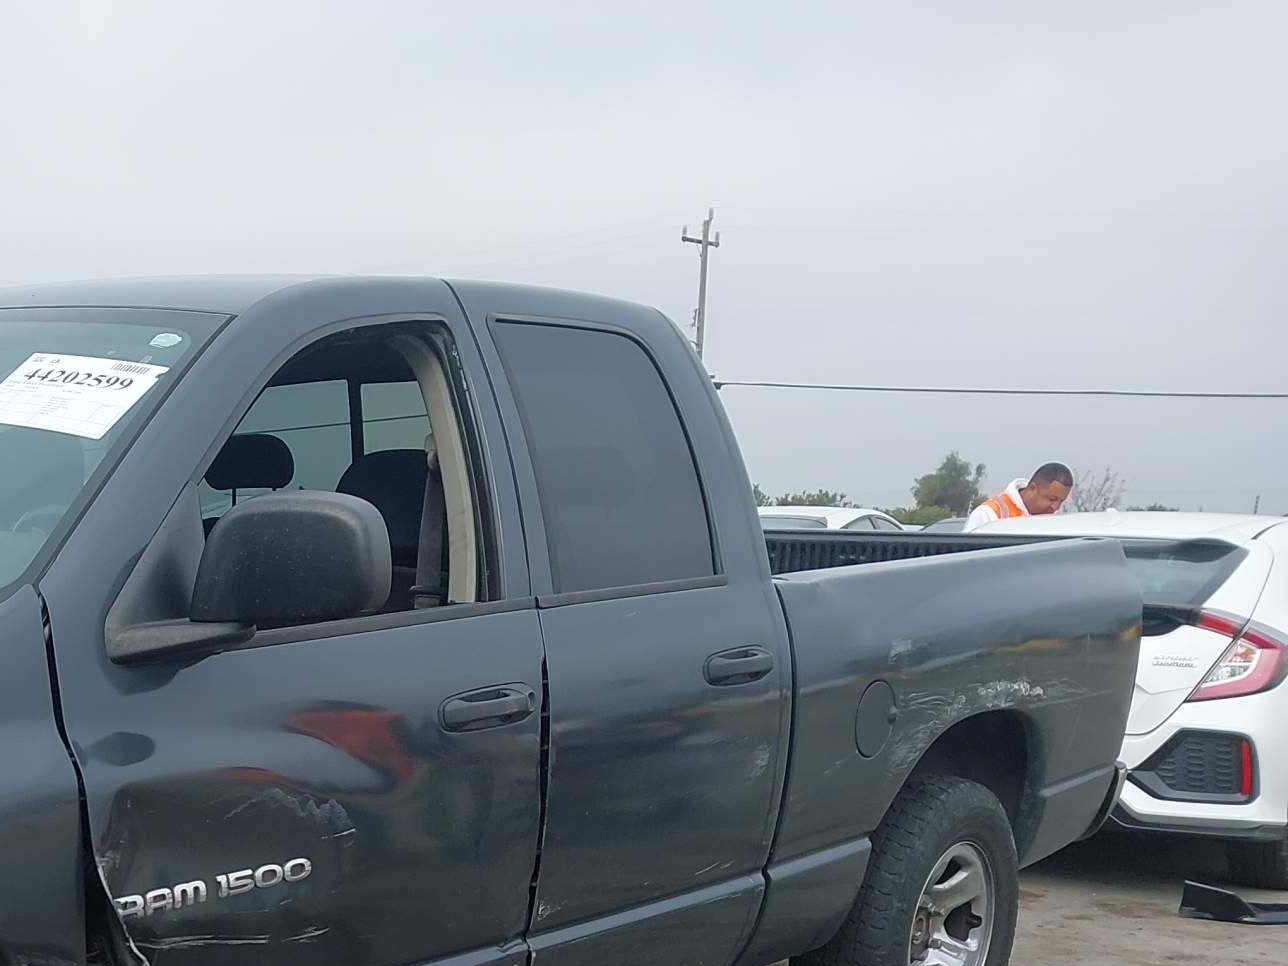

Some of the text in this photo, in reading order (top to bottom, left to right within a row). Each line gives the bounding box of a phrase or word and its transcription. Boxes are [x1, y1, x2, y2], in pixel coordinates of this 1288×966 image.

[23, 367, 134, 391] 44202599
[113, 857, 312, 919] RAM 1500
